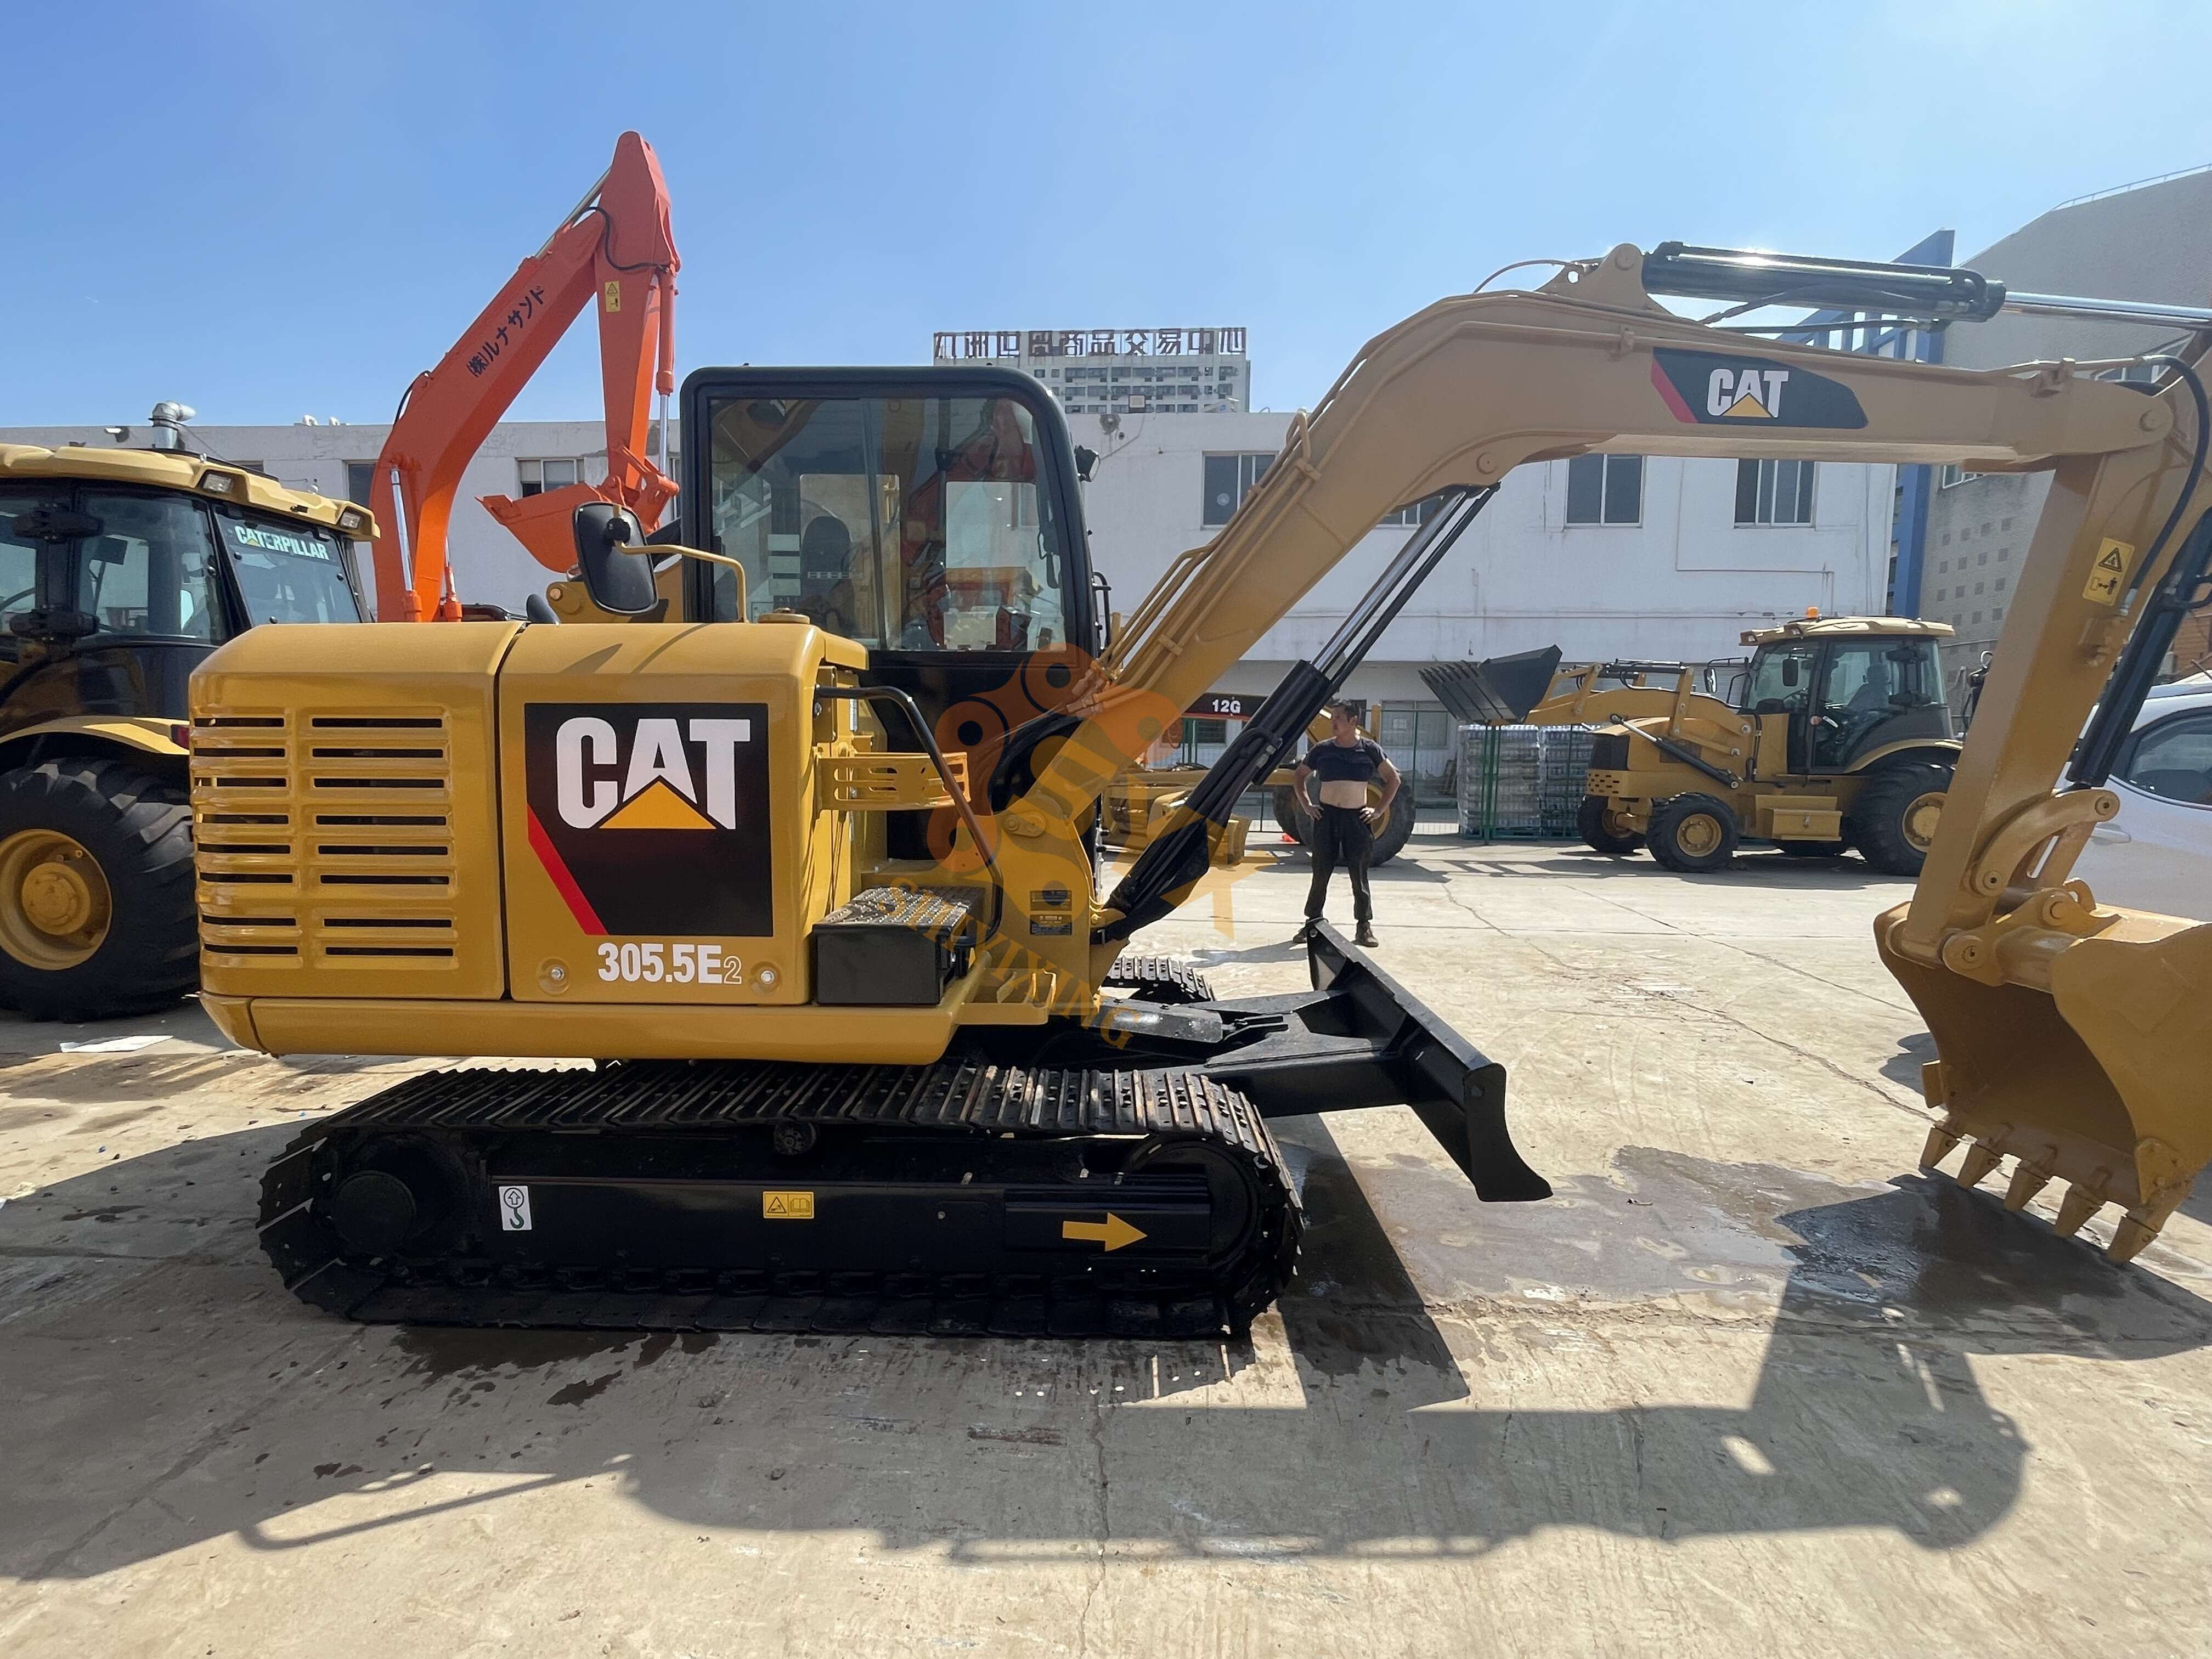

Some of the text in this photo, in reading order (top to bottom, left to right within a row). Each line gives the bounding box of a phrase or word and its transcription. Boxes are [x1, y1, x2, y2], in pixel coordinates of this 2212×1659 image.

[1707, 369, 1789, 418] CAT
[234, 526, 330, 560] CATERPILLAR
[1212, 699, 1241, 714] 12G
[556, 717, 751, 830] CAT
[598, 943, 742, 984] 305.5E2
